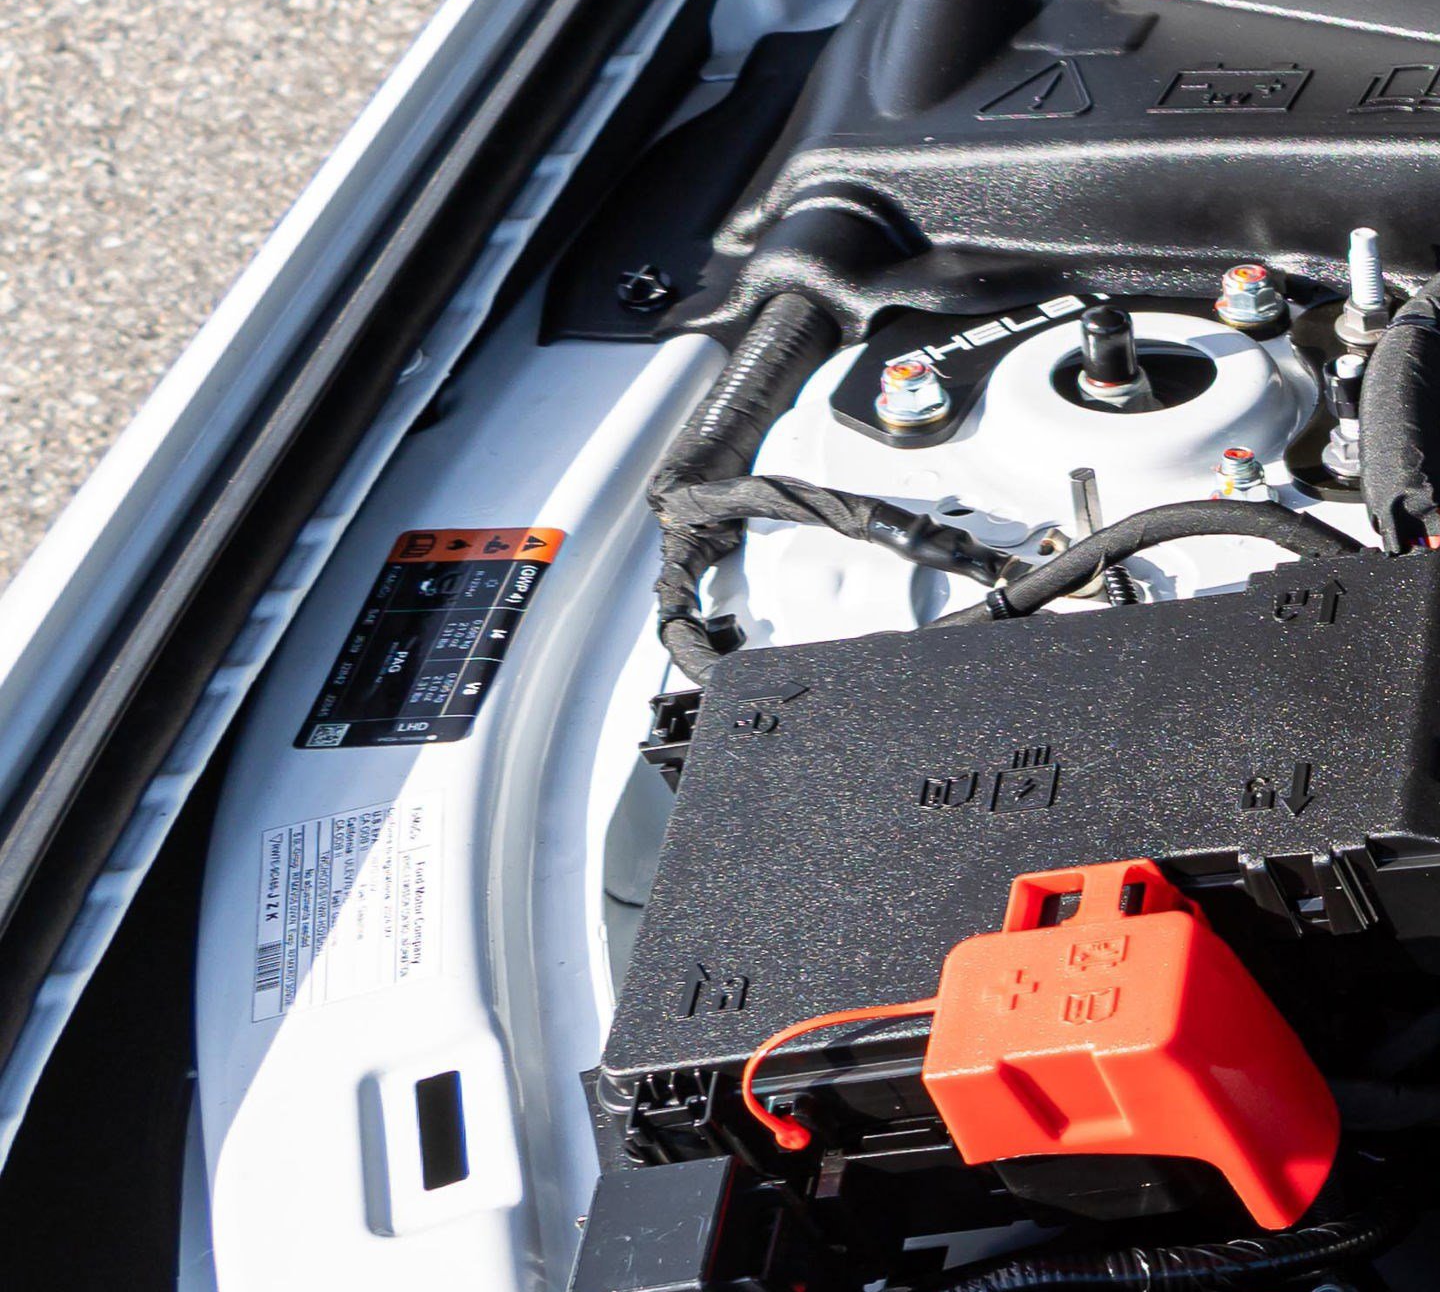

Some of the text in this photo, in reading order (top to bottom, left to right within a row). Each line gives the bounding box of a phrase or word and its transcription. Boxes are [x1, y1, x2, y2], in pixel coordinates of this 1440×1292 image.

[885, 292, 1112, 370] SHELB
[503, 565, 538, 603] (GWP 4)
[386, 651, 409, 672] PAG
[460, 681, 482, 695] V8
[394, 721, 430, 731] LHD
[334, 818, 343, 832] CA
[359, 812, 369, 826] CA
[298, 878, 312, 921] adjustments
[410, 860, 425, 966] Ford Motor Company
[299, 921, 311, 949] needed
